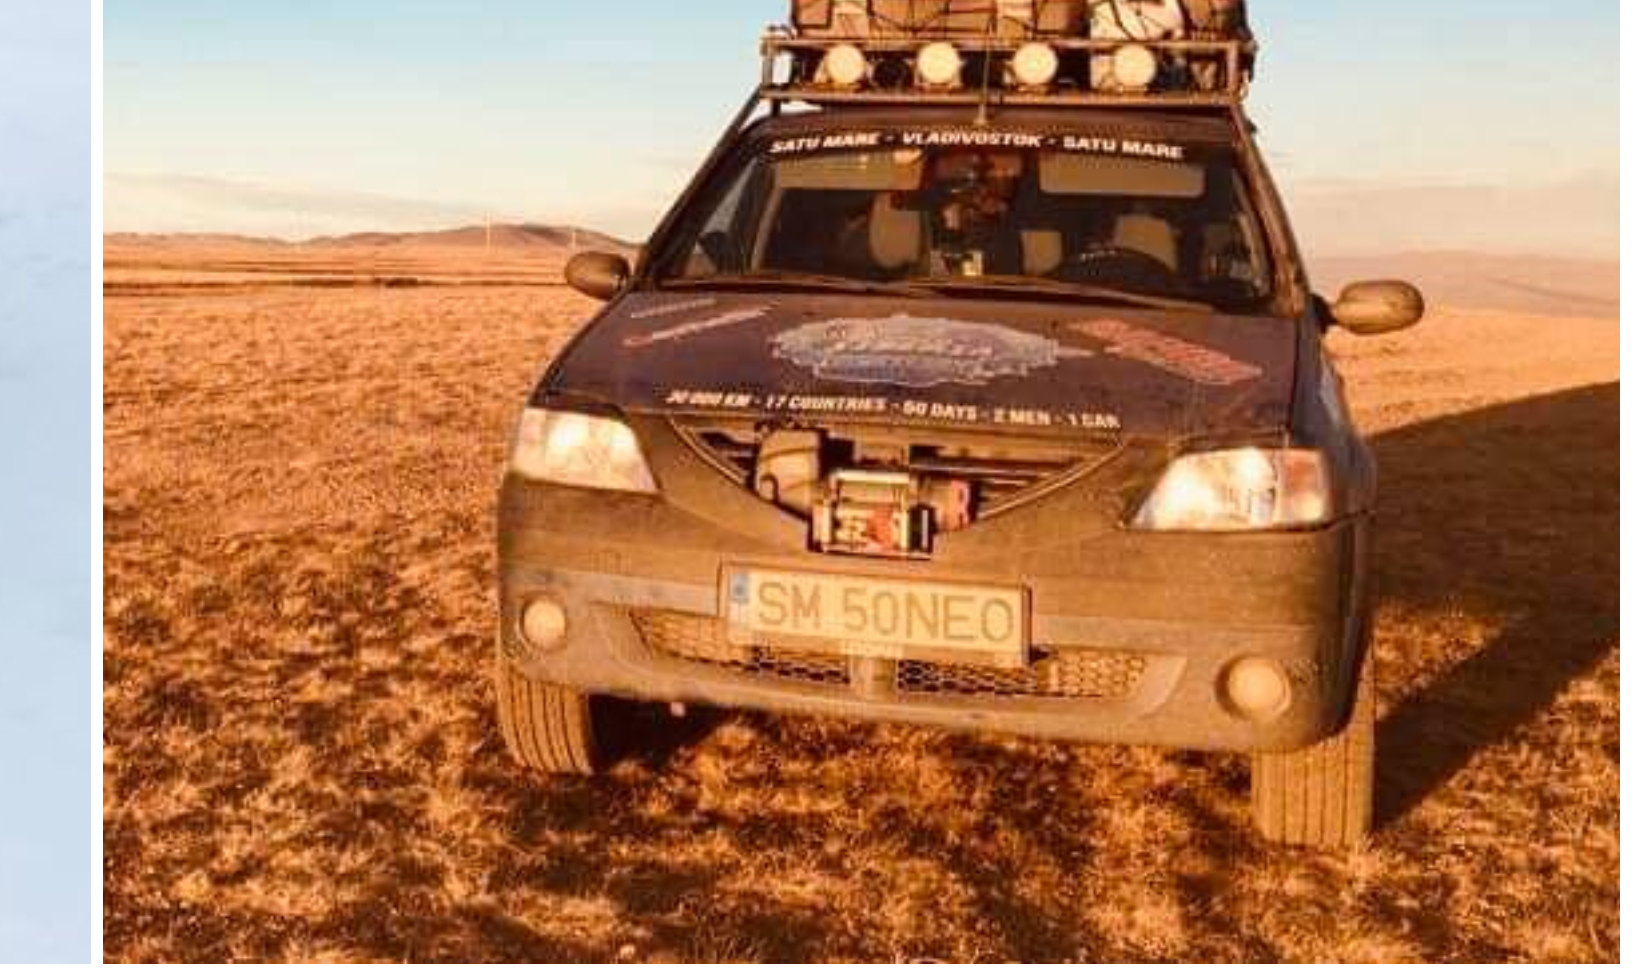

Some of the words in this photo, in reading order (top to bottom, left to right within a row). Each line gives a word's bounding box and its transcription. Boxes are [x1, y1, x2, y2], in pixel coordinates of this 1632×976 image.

[770, 136, 817, 154] SATU
[823, 131, 880, 149] MARE
[902, 130, 1044, 148] VLADIVOSTOK
[1063, 135, 1116, 153] SATU
[1121, 141, 1185, 160] MARE
[766, 395, 787, 410] 17
[788, 395, 887, 412] COUNTRIES
[902, 401, 927, 416] 50
[930, 403, 978, 421] DAYS
[1009, 408, 1052, 425] MEN
[758, 580, 821, 627] SM
[843, 585, 1015, 642] 50NEO
